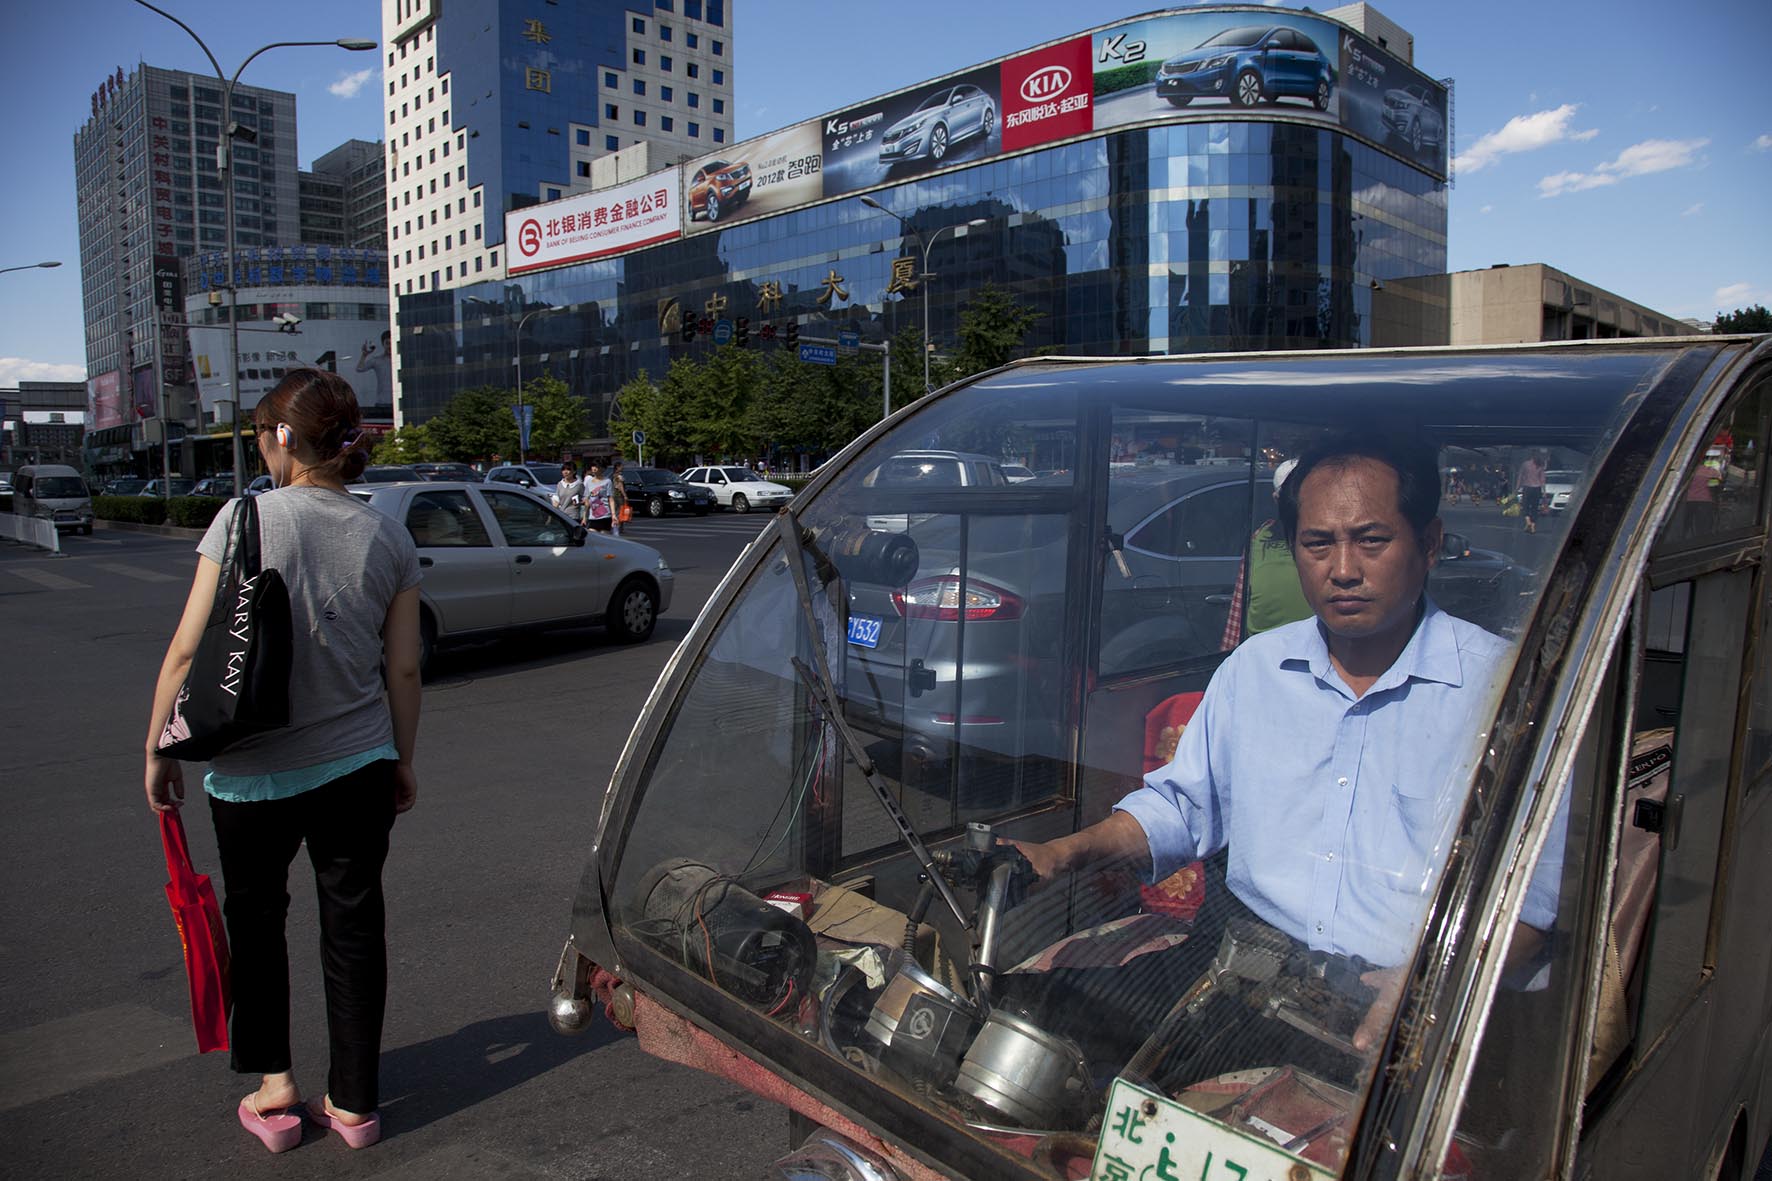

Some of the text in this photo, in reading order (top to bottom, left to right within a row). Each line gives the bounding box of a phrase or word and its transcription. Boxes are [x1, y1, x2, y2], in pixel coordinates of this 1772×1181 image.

[1099, 33, 1147, 63] K2
[1029, 71, 1064, 97] KIA
[826, 118, 849, 135] K5
[546, 188, 669, 239] 北银消费金融公司
[546, 213, 667, 249] BANK OF BEIJING CONSUMER FINANCE COMPANY
[705, 256, 920, 320] 中科大厦
[220, 575, 258, 696] MARY KAY
